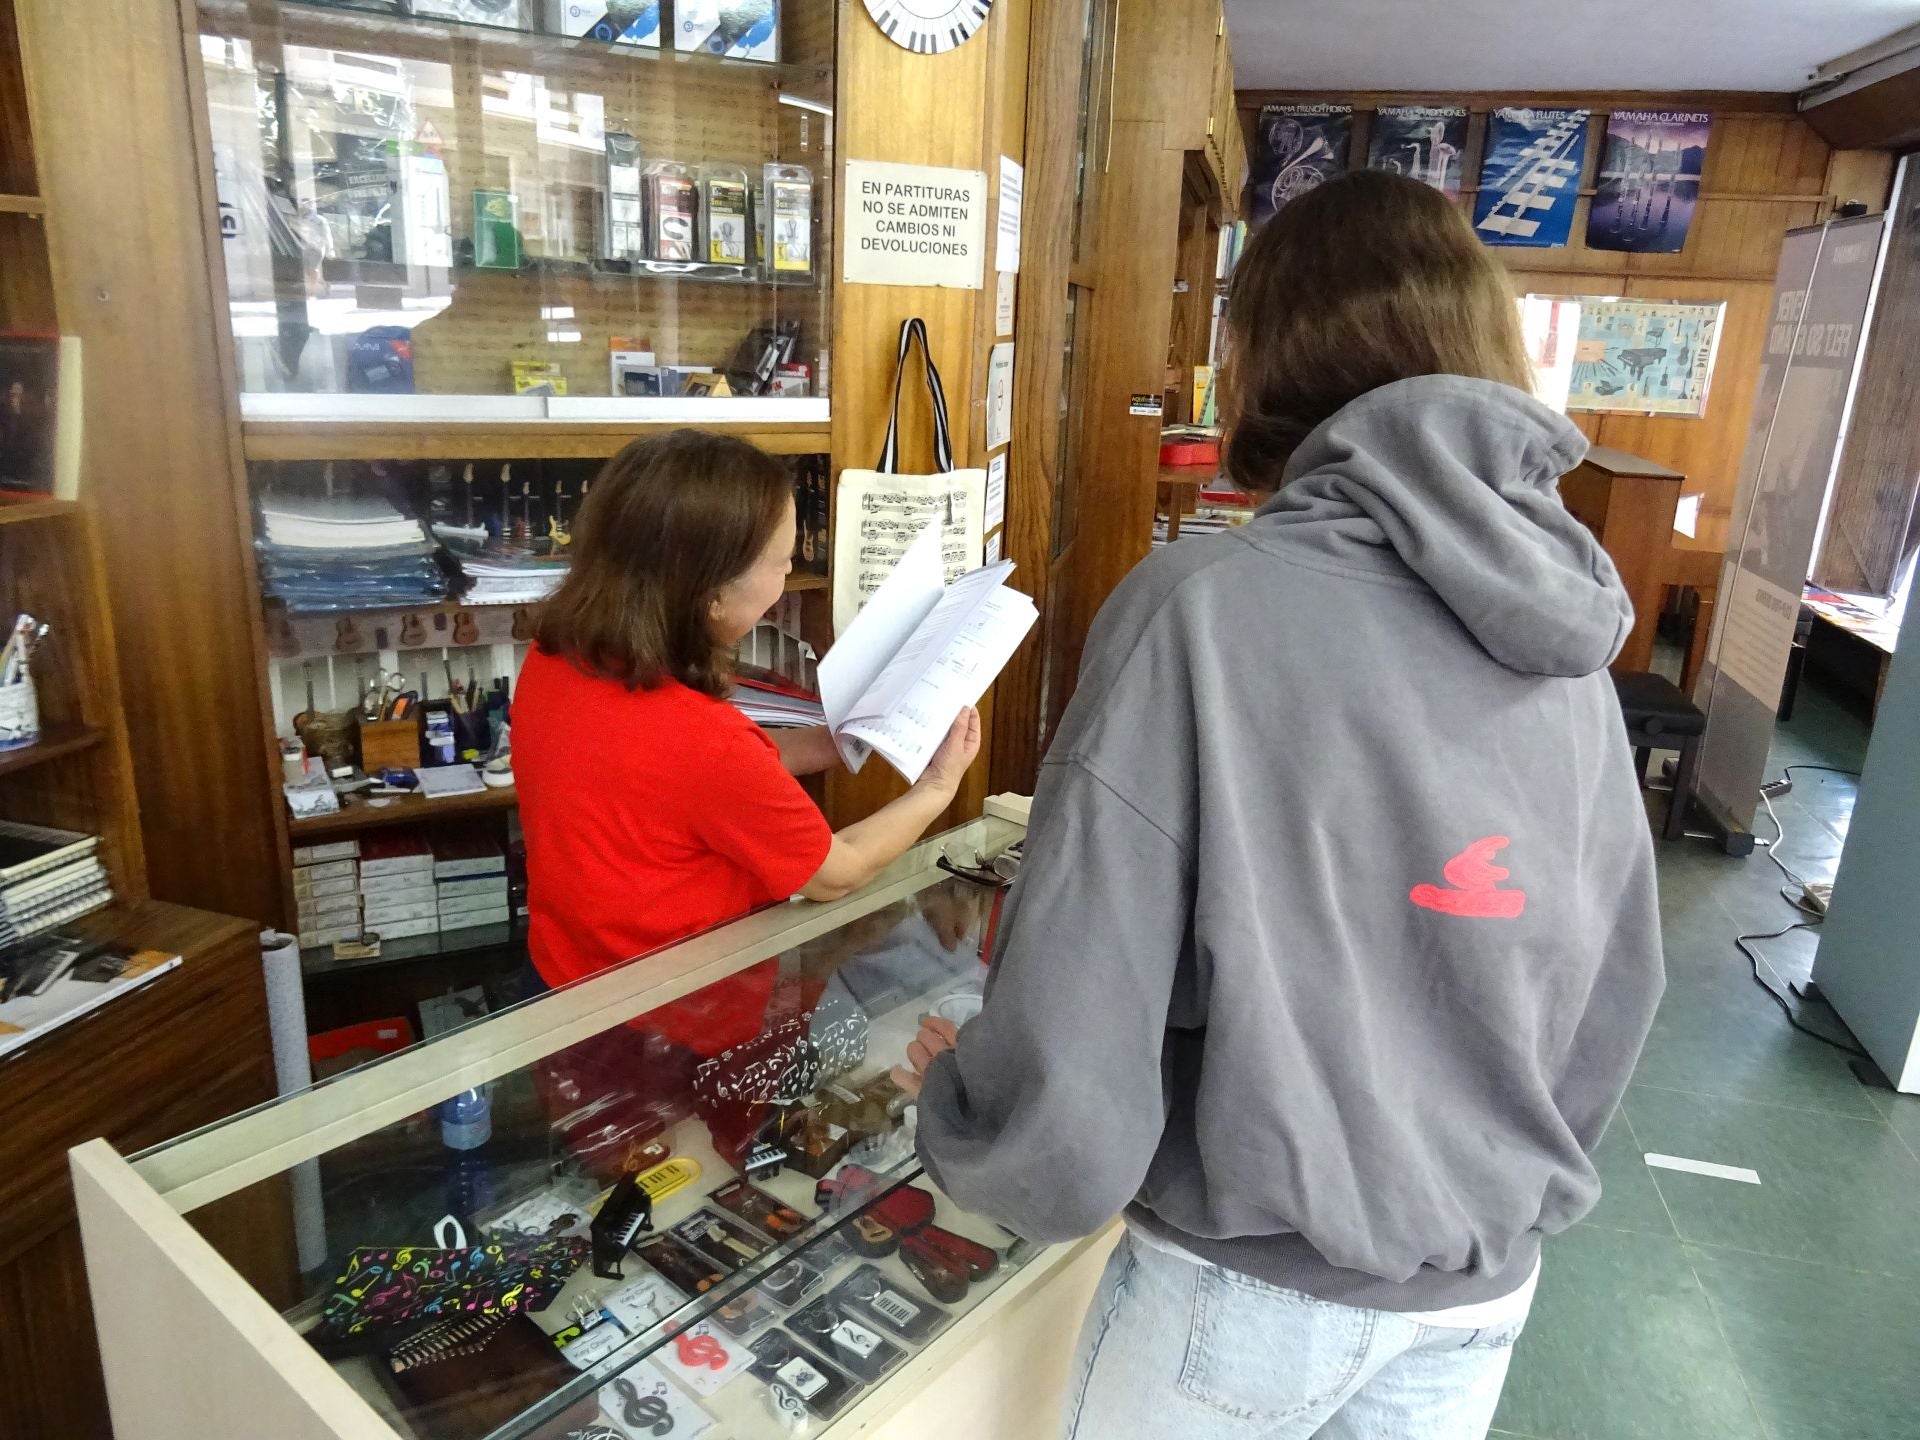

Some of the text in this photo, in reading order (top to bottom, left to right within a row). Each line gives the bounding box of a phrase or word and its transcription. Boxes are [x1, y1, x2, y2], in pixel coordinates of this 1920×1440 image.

[1262, 104, 1296, 114] YAMAHA
[1376, 106, 1414, 117] YAMAHA
[1535, 110, 1566, 120] FLUTES
[1613, 111, 1709, 123] YAMAHA CLARINETS
[862, 181, 970, 203] EN PARTITURAS
[863, 200, 968, 220] NO SE ADMITEN
[876, 219, 955, 238] CAMBIOS NI
[861, 237, 968, 256] DEVOLUCIONES
